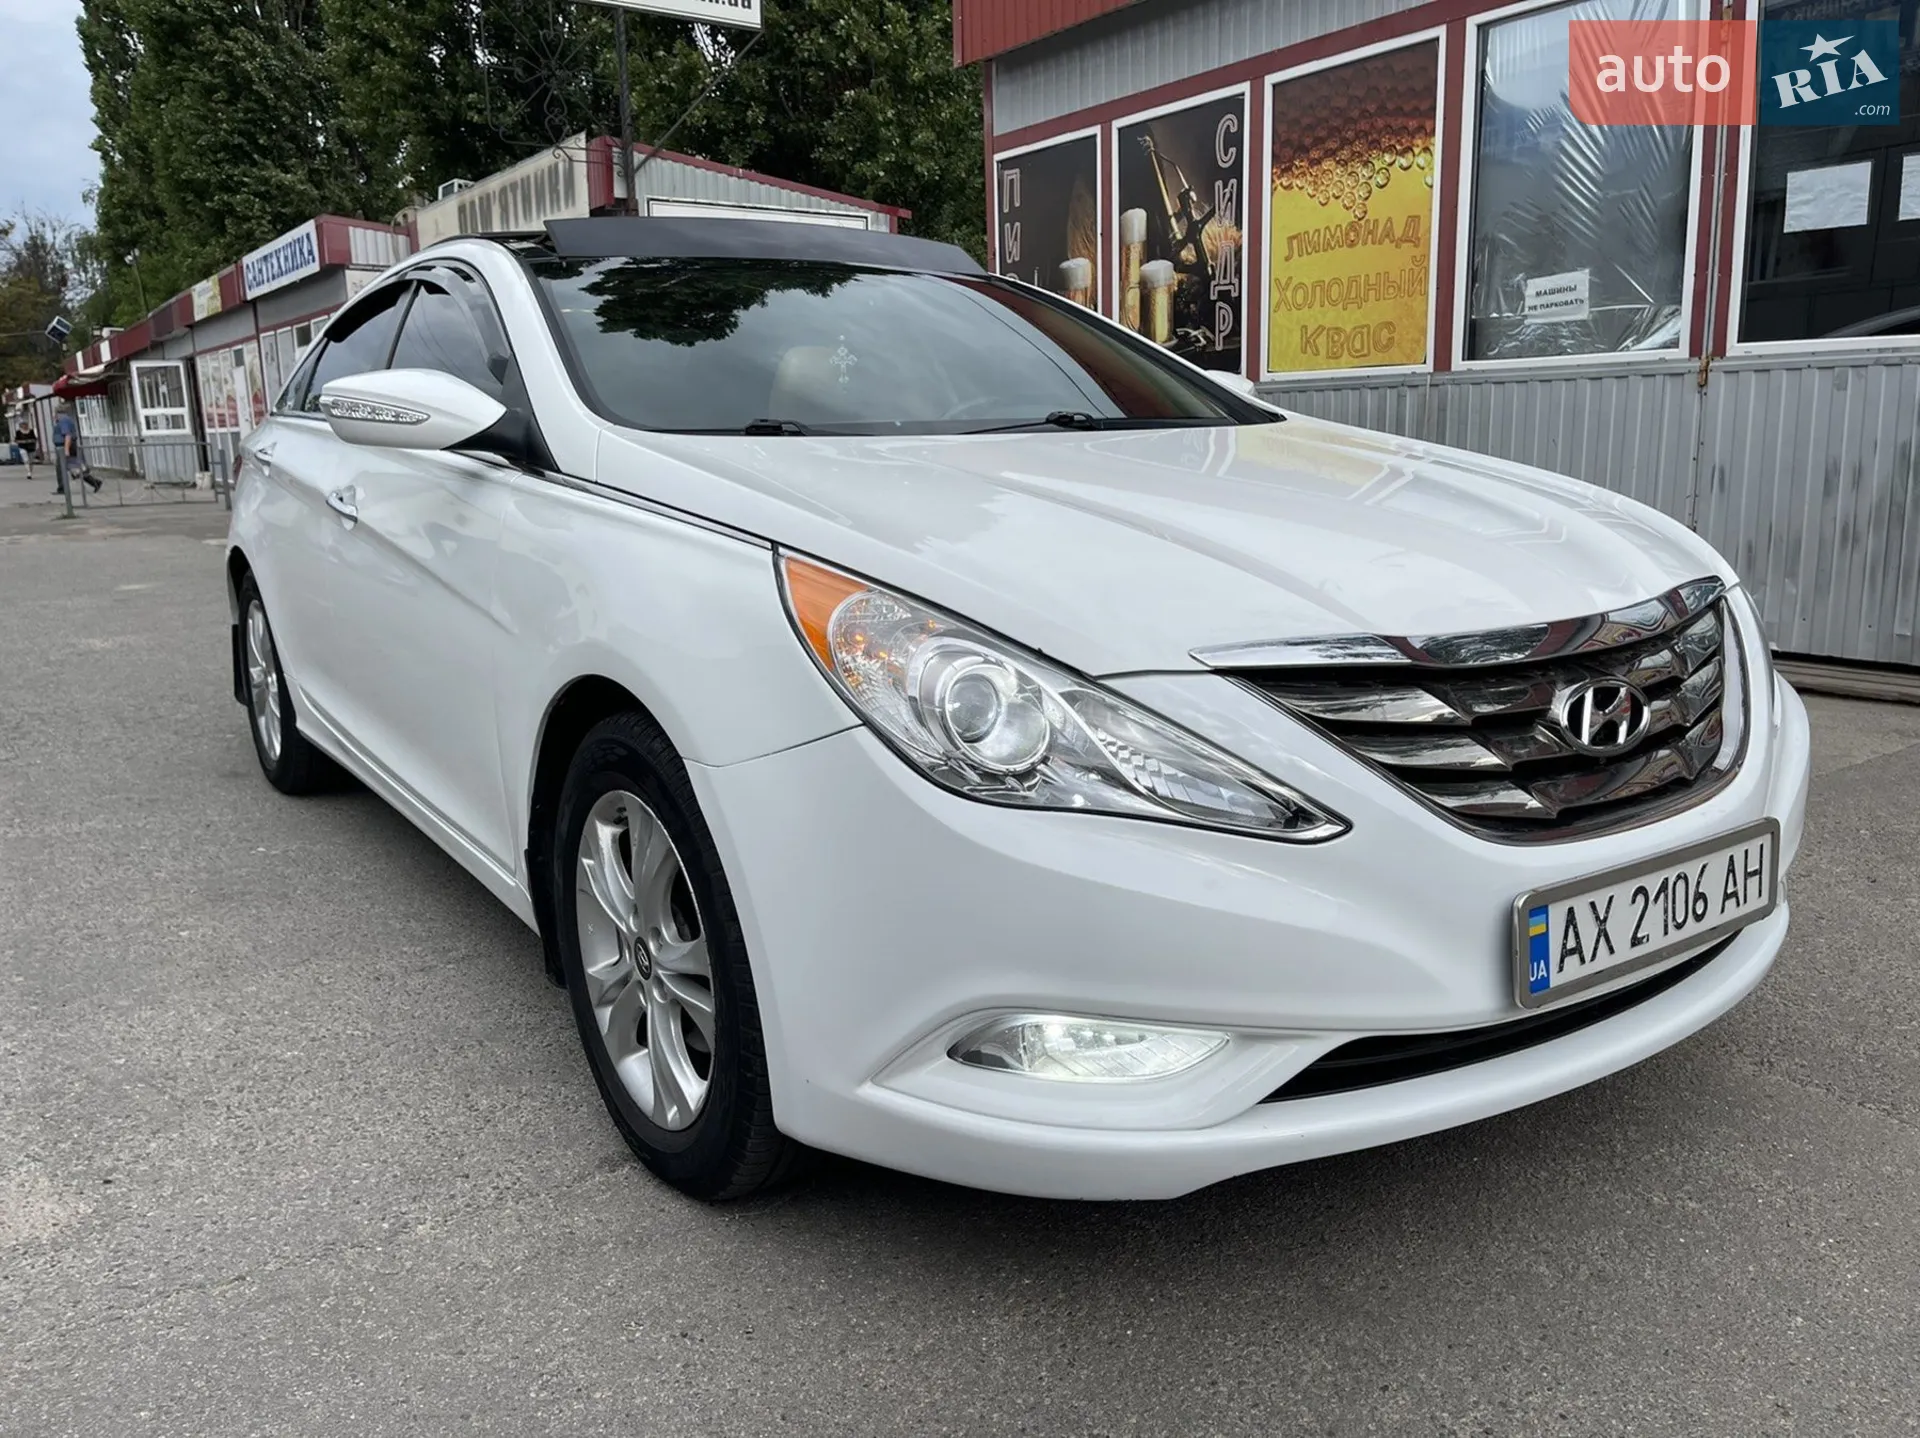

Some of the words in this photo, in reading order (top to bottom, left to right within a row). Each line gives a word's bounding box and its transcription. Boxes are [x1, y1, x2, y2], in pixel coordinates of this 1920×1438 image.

[1003, 168, 1020, 280] ПИ
[1210, 114, 1239, 350] СИДР
[1284, 215, 1421, 262] ЛИМОНАД
[245, 232, 316, 292] САНТЕХНИКА
[1528, 304, 1538, 312] НЕ
[1540, 298, 1584, 311] ПАРКОВАТЬ
[1535, 284, 1577, 297] МАШИНЫ
[1557, 894, 1615, 974] AX
[1629, 862, 1709, 949] 2106
[1720, 843, 1764, 915] AH
[1528, 959, 1548, 982] UA
